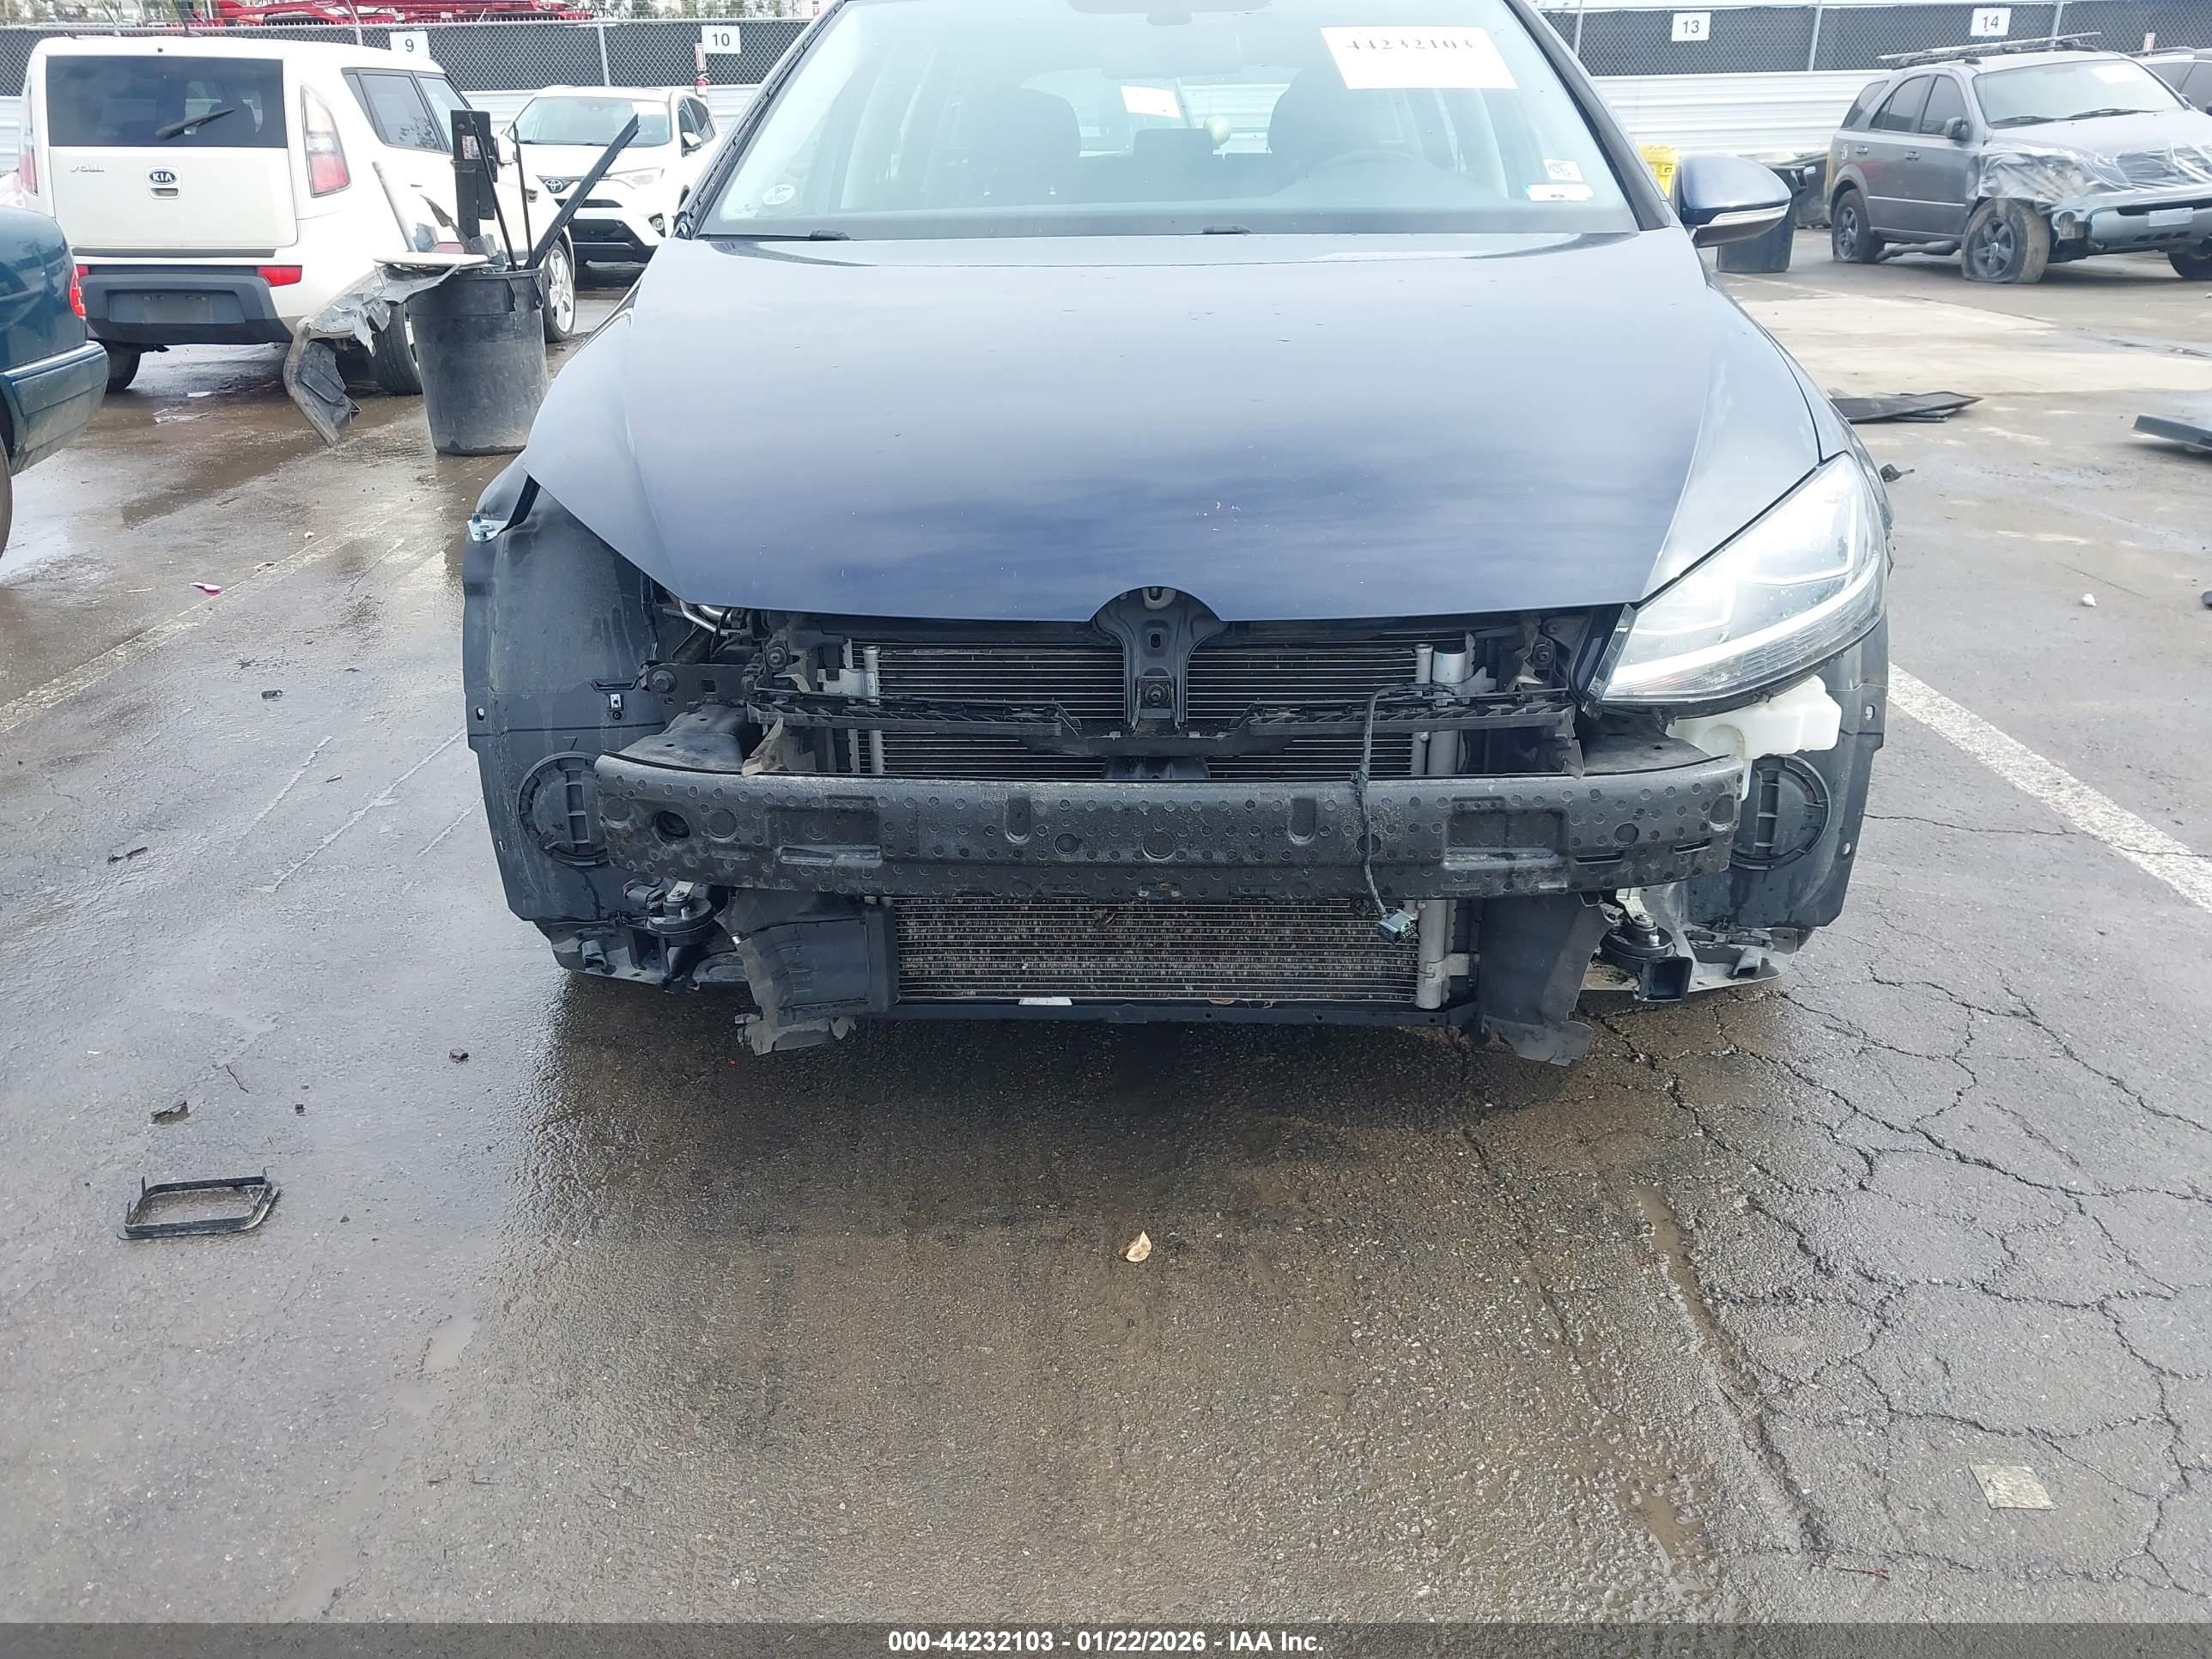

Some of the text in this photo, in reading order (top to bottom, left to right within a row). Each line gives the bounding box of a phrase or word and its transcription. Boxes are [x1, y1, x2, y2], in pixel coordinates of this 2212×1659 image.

[1683, 20, 1699, 33] 13
[1983, 15, 1999, 29] 14
[404, 39, 414, 52] 9
[711, 33, 730, 46] 10
[151, 172, 173, 182] KIA
